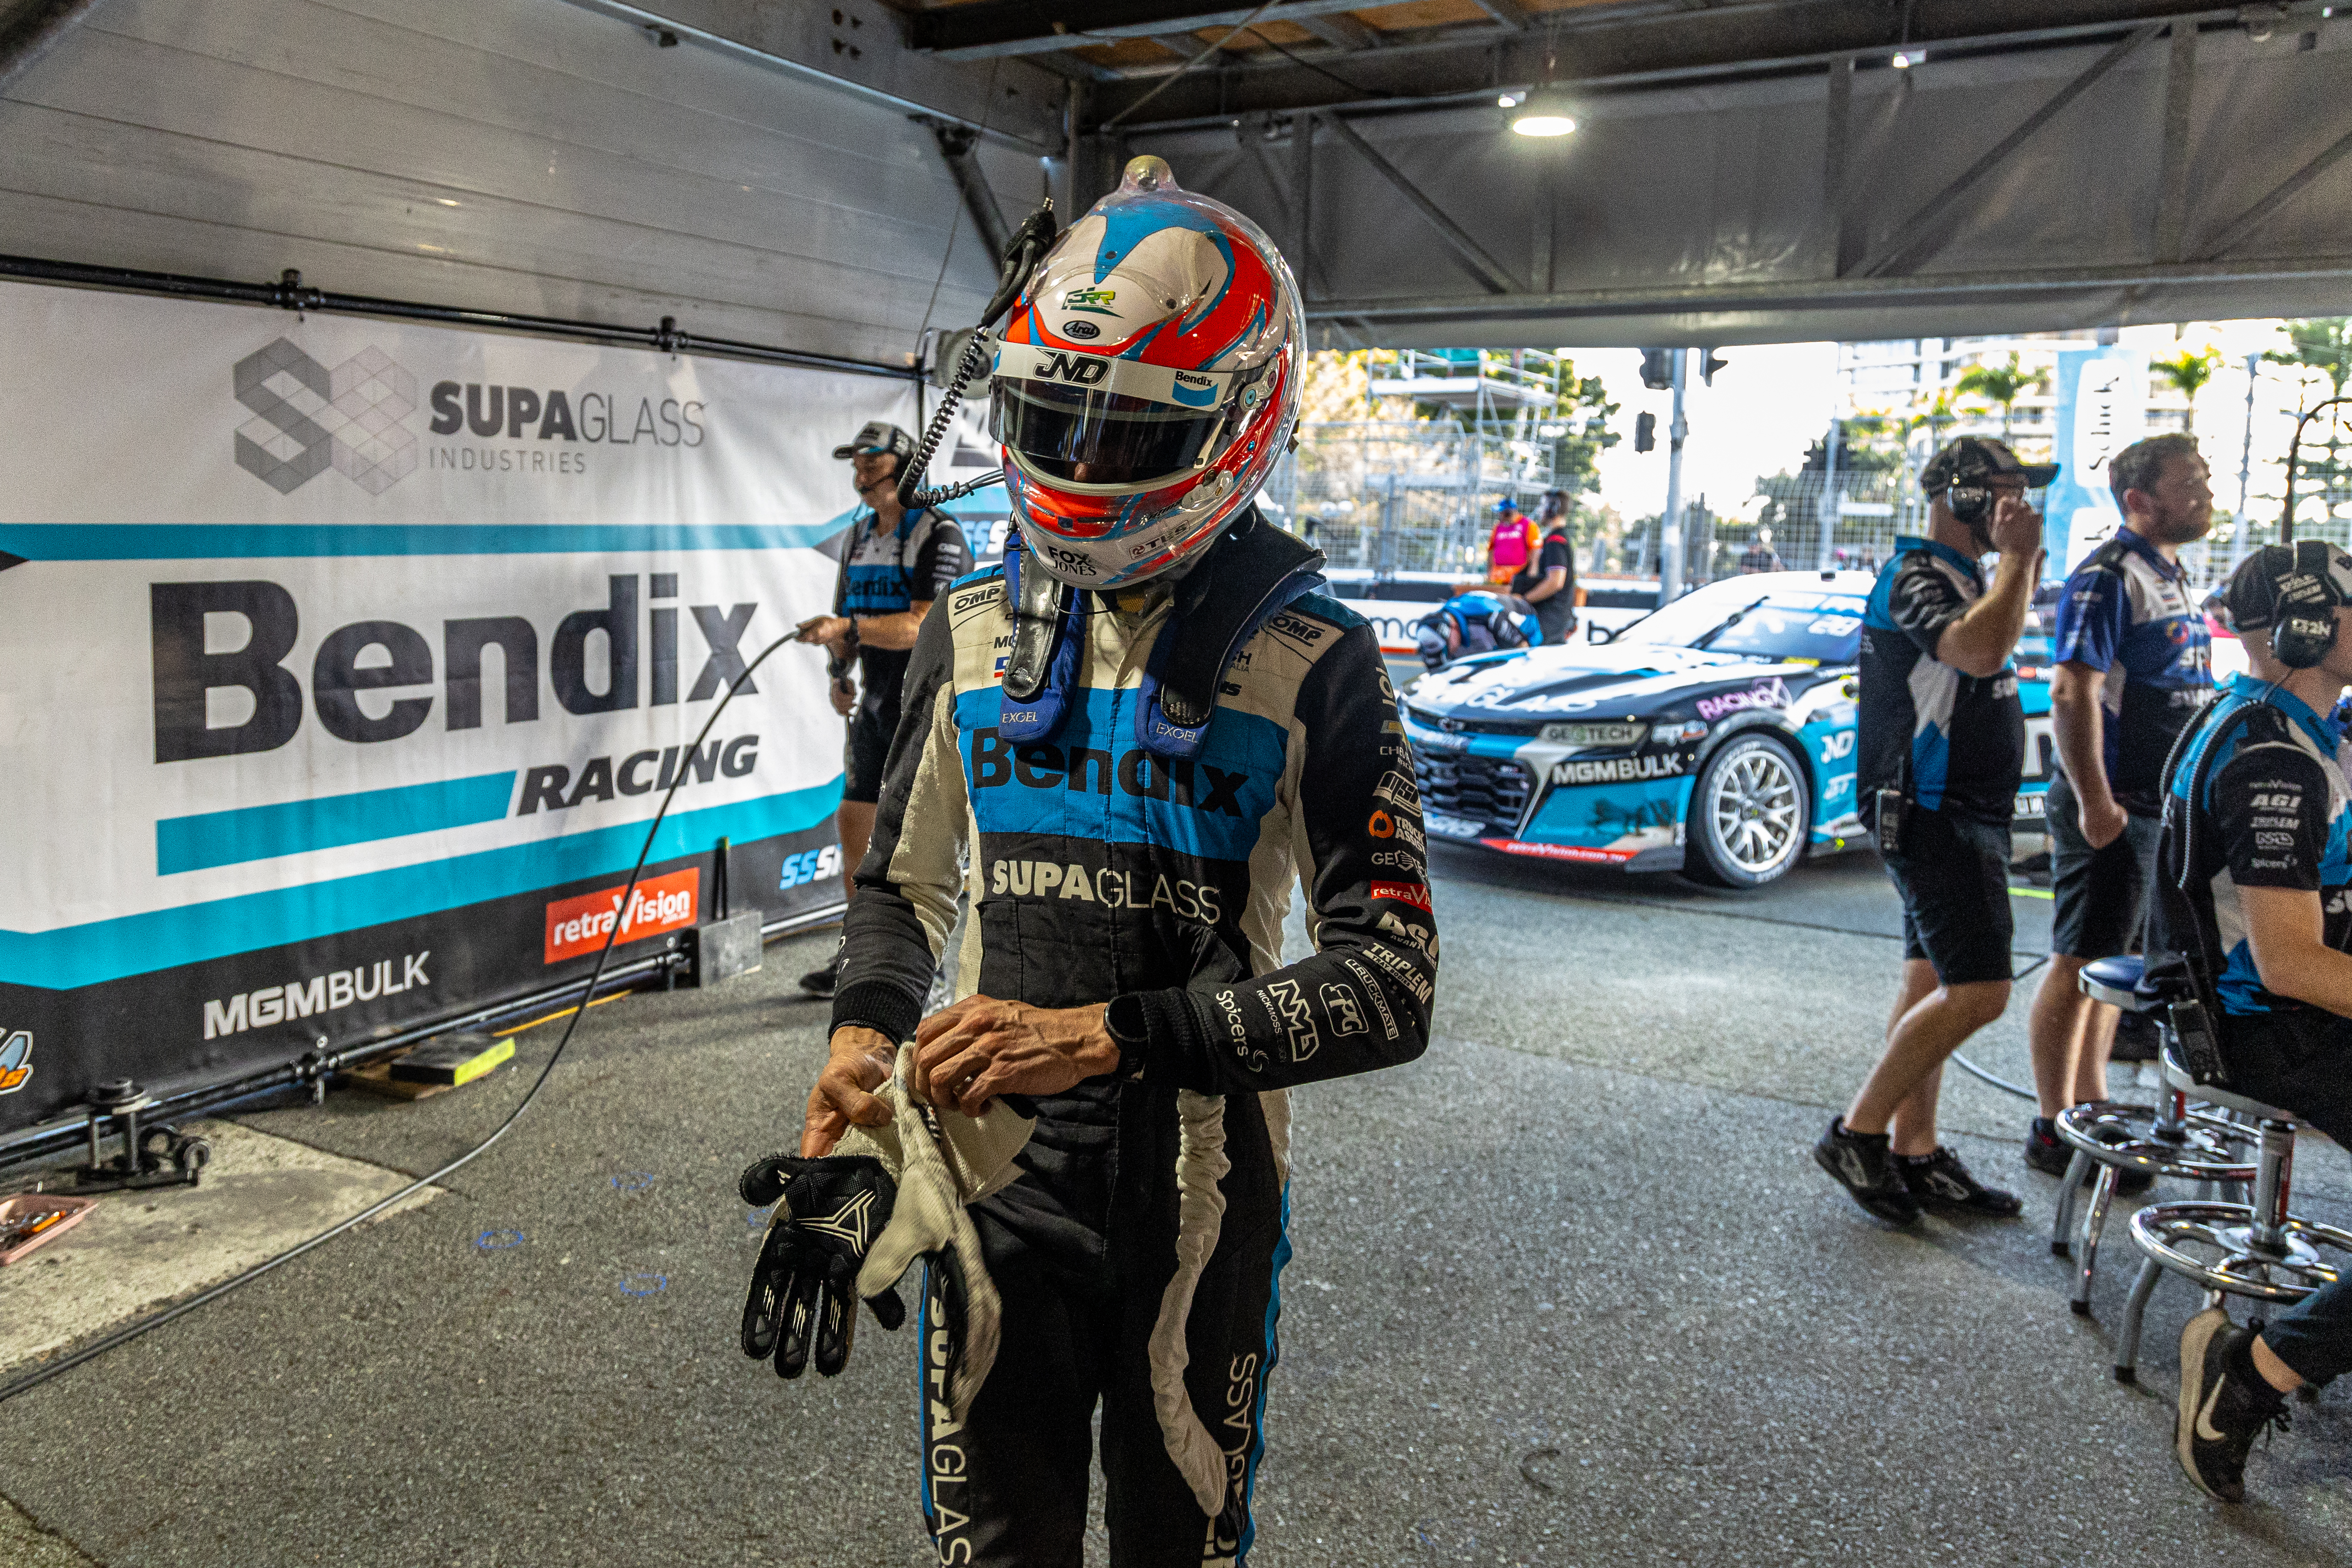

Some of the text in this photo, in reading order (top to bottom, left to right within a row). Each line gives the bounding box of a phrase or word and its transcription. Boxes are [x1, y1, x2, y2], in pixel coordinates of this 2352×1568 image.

[1175, 370, 1212, 387] Bendix
[429, 381, 704, 447] SUPAGLASS
[429, 447, 586, 474] INDUSTRIES
[1047, 545, 1091, 566] FOX
[1052, 560, 1097, 576] JONES
[954, 587, 1001, 610] OMP
[1272, 617, 1322, 641] OMP
[150, 572, 759, 765] Bendix
[1002, 712, 1038, 724] EXGEL
[1156, 722, 1198, 743] EXGEL
[516, 734, 759, 817] RACING
[971, 726, 1250, 818] Bendix
[1552, 753, 1683, 785] MGMBULK
[1394, 815, 1425, 845] TRUCK
[992, 860, 1221, 924] SUPAGLASS
[553, 889, 690, 946] retraVision
[204, 950, 430, 1040] MGMBULK
[1350, 960, 1397, 1039] TRUCKMATE
[1216, 990, 1249, 1057] Spicers
